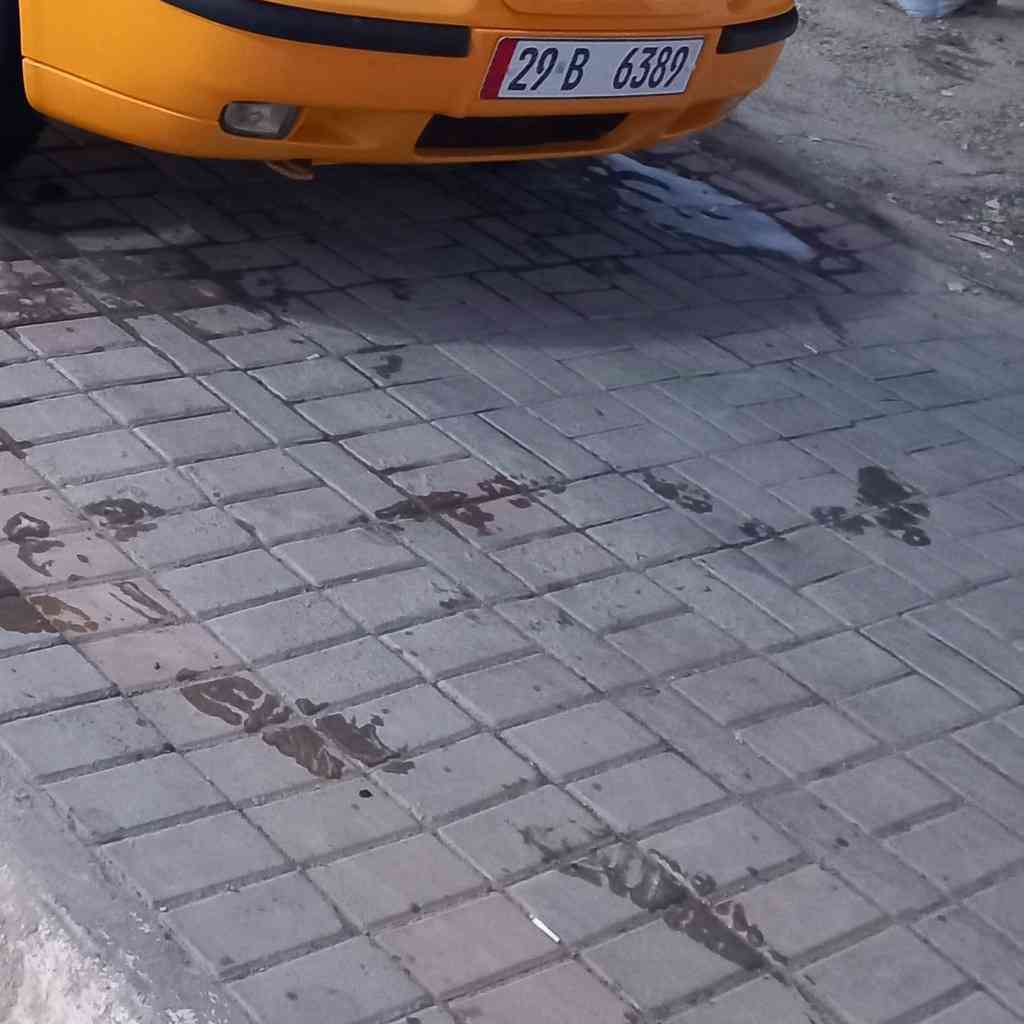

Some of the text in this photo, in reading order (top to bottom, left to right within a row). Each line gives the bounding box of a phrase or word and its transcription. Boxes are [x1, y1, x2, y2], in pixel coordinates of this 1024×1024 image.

[508, 46, 690, 91] 29 B 6389
